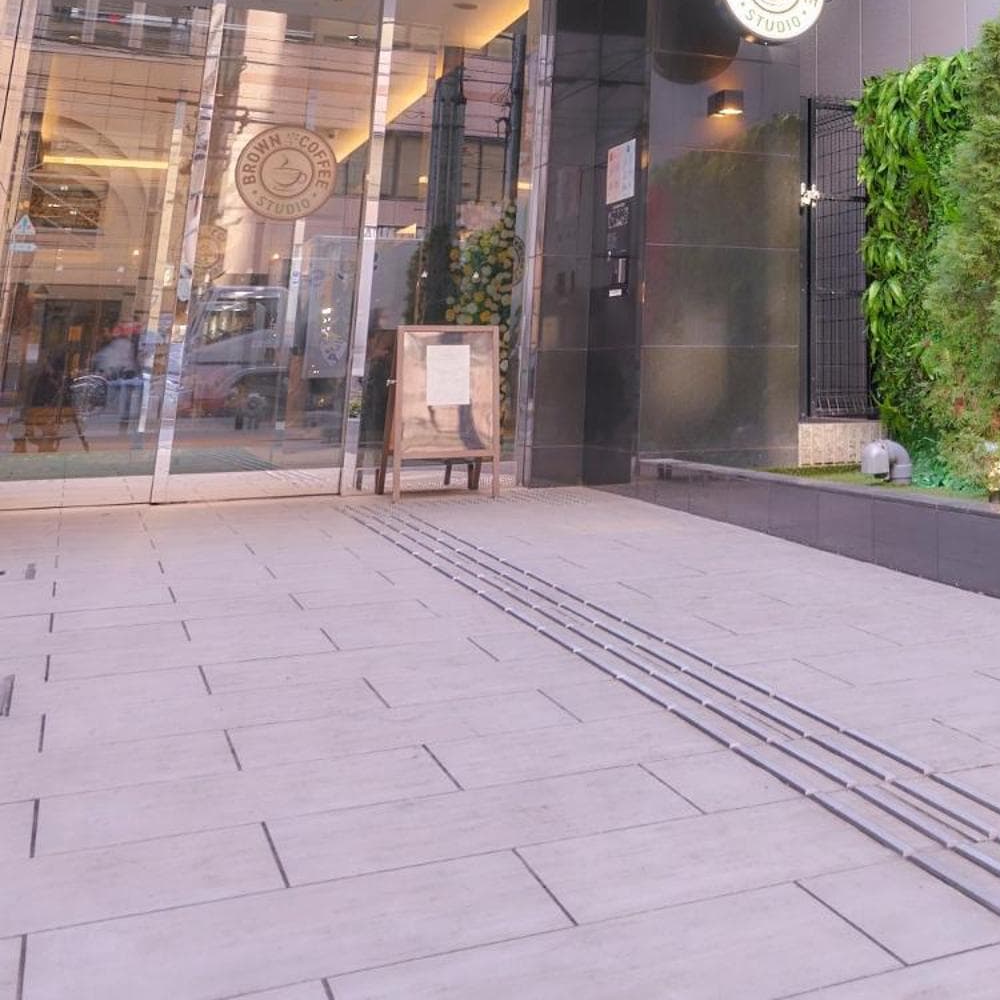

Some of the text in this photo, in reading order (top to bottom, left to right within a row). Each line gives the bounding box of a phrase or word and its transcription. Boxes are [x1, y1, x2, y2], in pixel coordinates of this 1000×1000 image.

[745, 8, 801, 33] STUDIO
[242, 133, 332, 191] BROWN COFFEE
[255, 195, 310, 215] STUDIO
